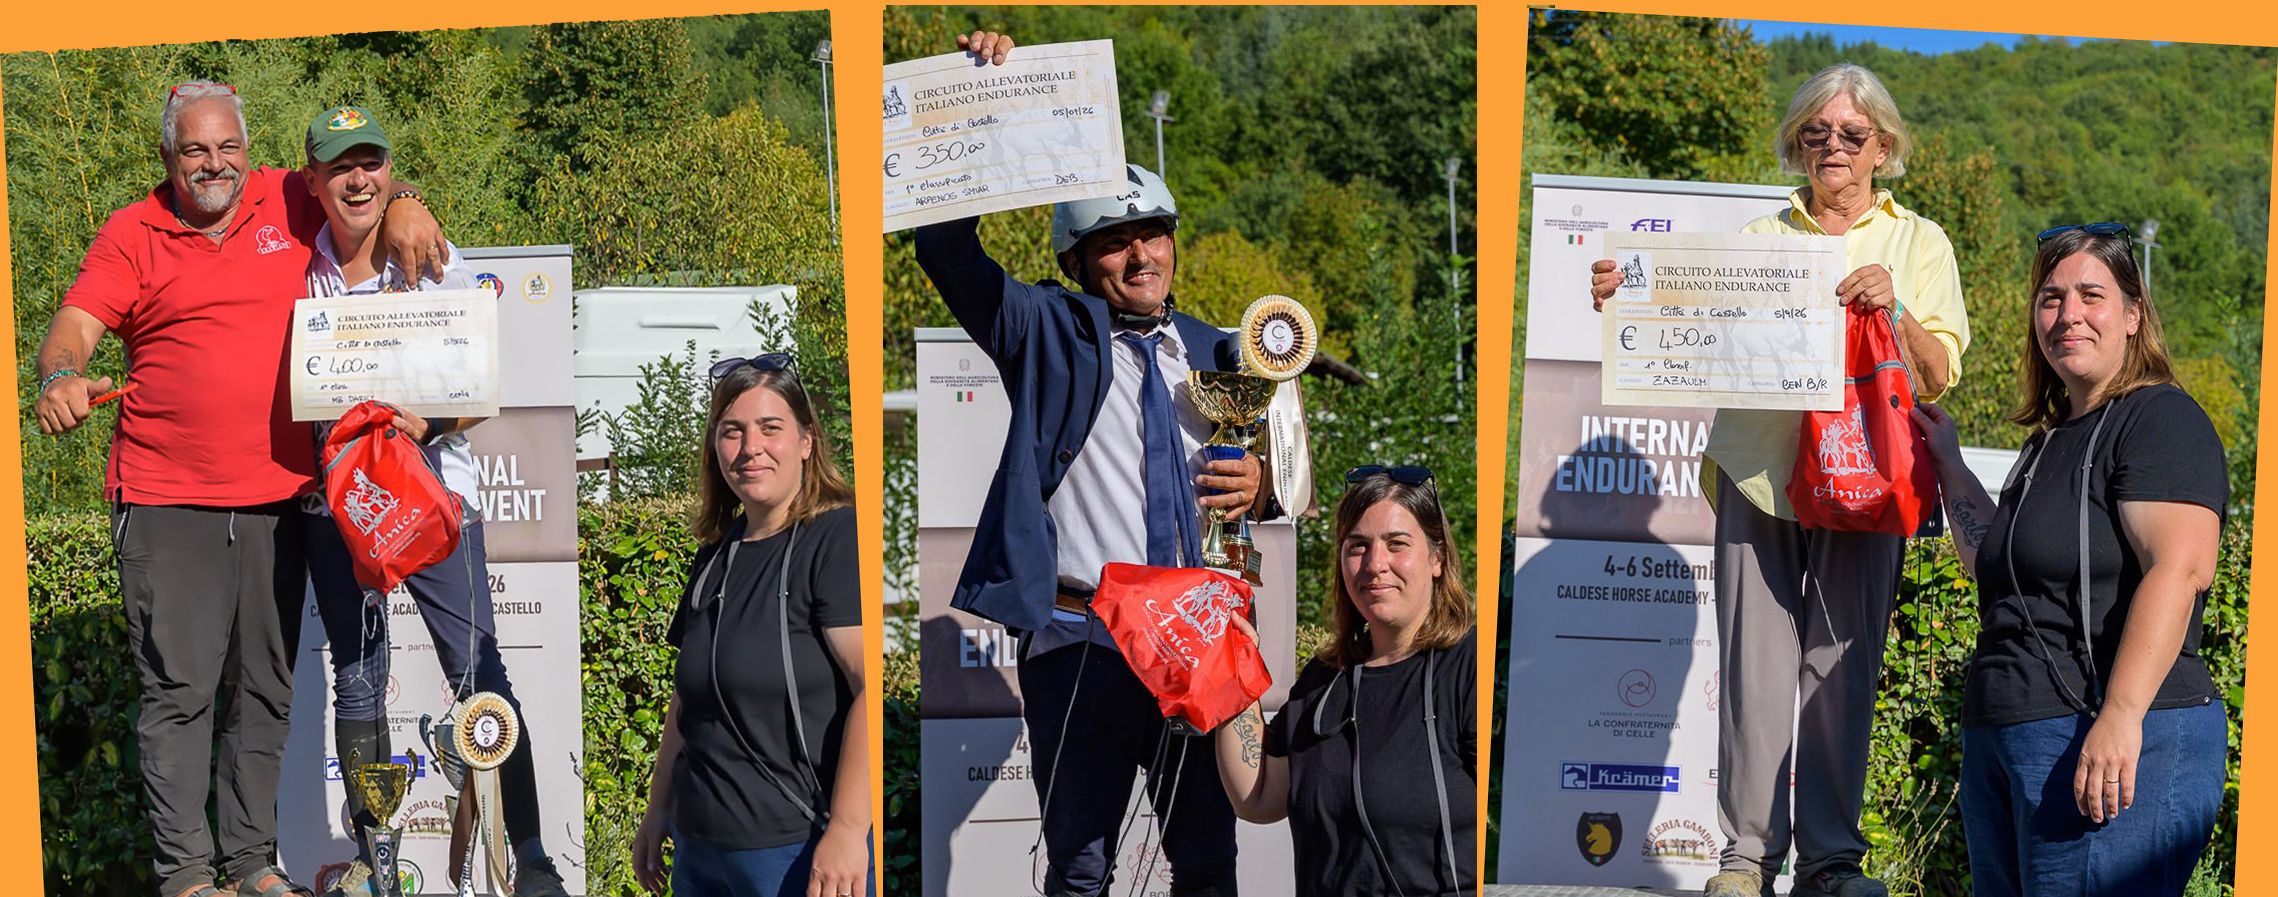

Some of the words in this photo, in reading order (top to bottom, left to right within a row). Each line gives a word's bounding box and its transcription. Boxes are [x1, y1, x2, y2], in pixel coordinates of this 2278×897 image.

[913, 82, 973, 100] CIRCUITO
[975, 70, 1077, 89] ALLEVATORIALE
[915, 94, 975, 114] ITALIANO
[978, 84, 1058, 102] ENDURANCE
[1655, 265, 1712, 277] CIRCUITO
[1713, 267, 1810, 279] ALLEVATORIALE
[1655, 280, 1712, 291] ITALIANO
[1715, 281, 1791, 292] ENDURANCE
[337, 313, 385, 323] CIRCUITO
[387, 309, 467, 321] ALLEVATORIALE
[337, 321, 386, 331] ITALIANO
[387, 318, 451, 329] ENDURANCE
[1619, 326, 1637, 351] €
[306, 355, 321, 376] €
[1556, 455, 1700, 498] ENDURAN
[1814, 476, 1882, 500] Anica
[369, 508, 421, 558] Anica
[1604, 555, 1637, 577] 4-6
[1557, 584, 1609, 600] CALDESE
[1612, 587, 1651, 602] HORSE
[1653, 589, 1709, 605] ACADEMY
[492, 602, 542, 615] CASTELLO
[1145, 599, 1200, 669] Anica
[1669, 636, 1712, 647] partners
[1588, 719, 1600, 727] LA
[1613, 729, 1623, 737] DI
[1626, 730, 1656, 738] CELLE
[968, 765, 1023, 782] CALDESE
[1598, 769, 1679, 787] Krämer
[1641, 819, 1681, 857] SELLERIA
[1683, 819, 1718, 860] GAMBONI
